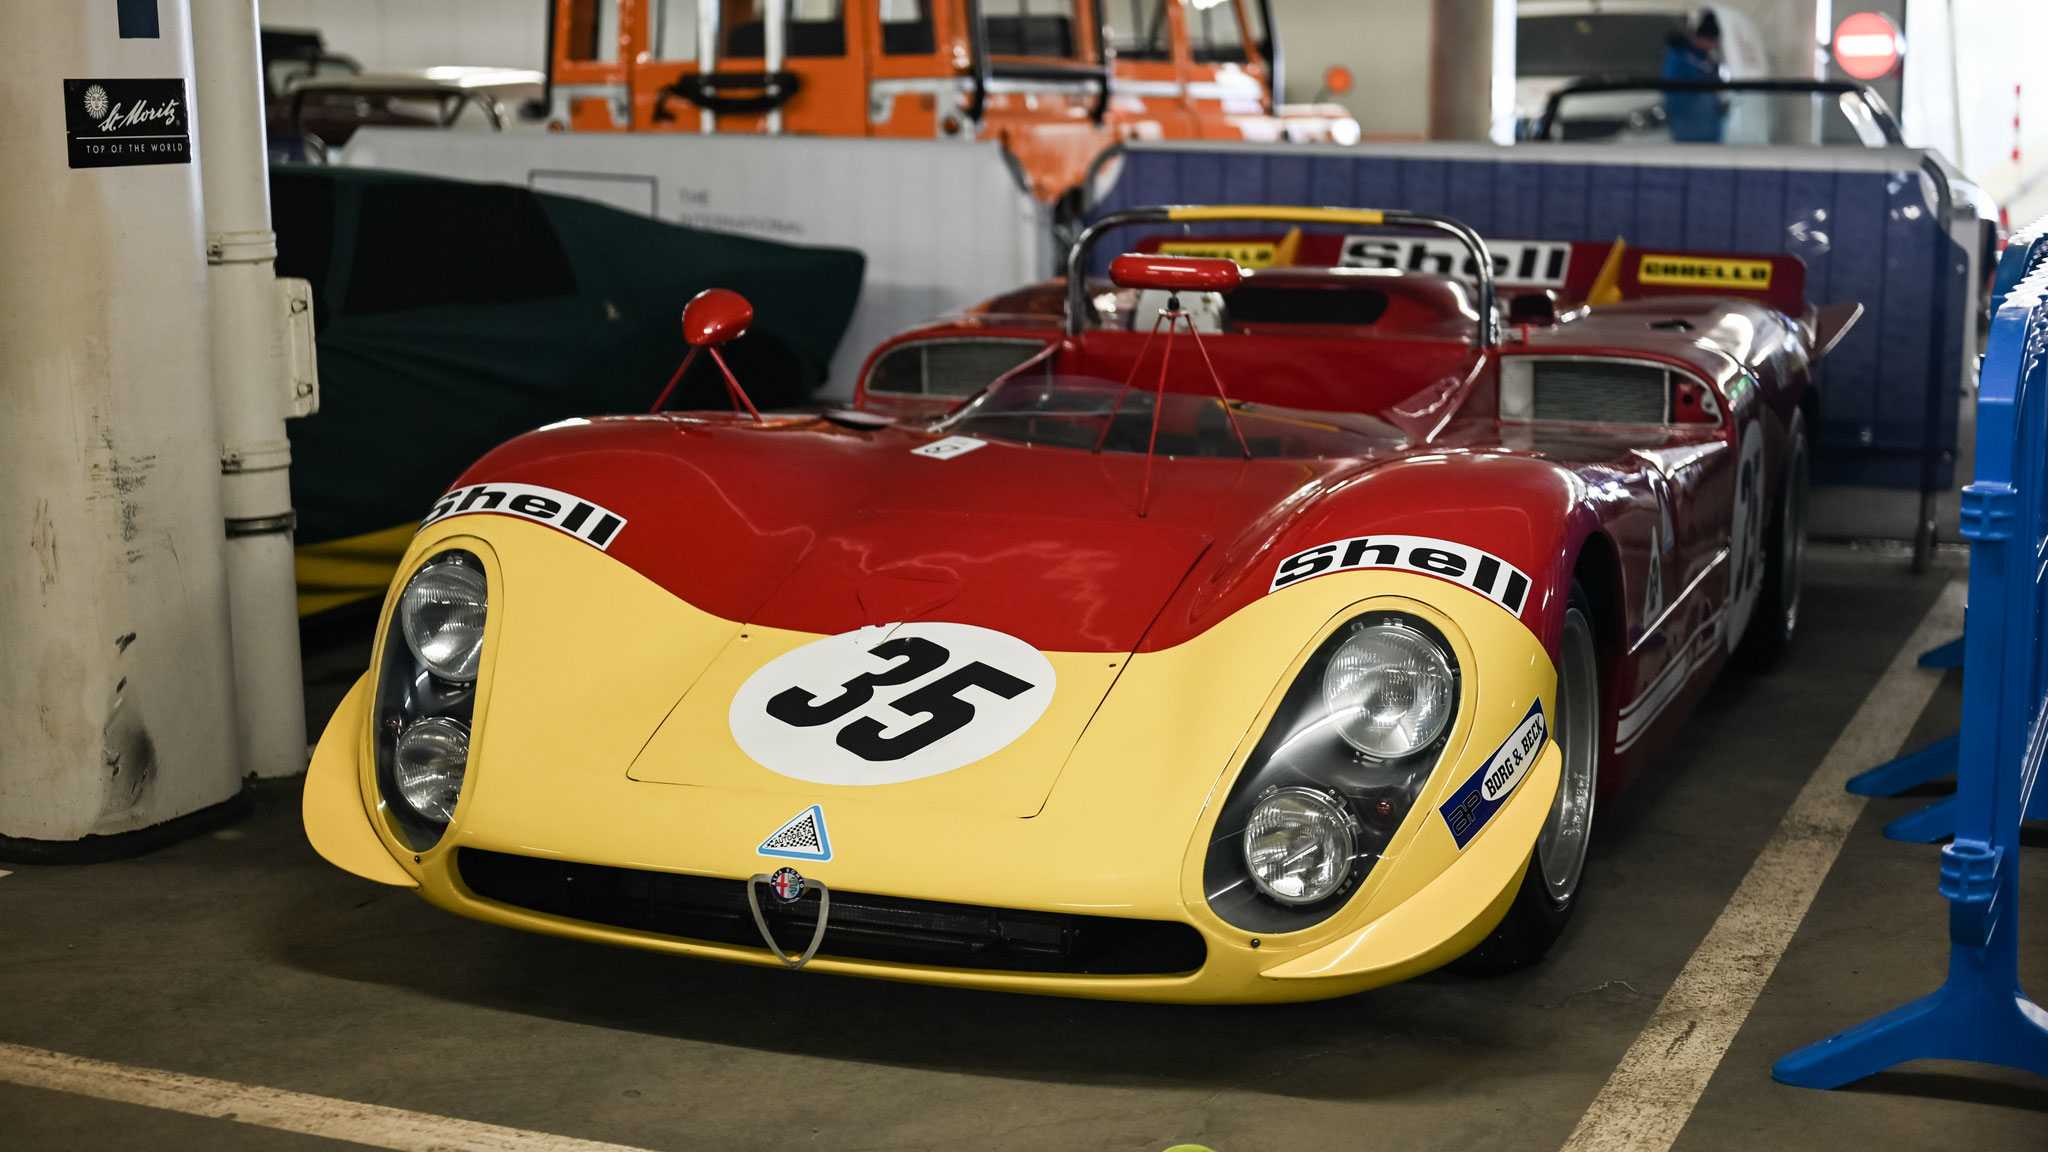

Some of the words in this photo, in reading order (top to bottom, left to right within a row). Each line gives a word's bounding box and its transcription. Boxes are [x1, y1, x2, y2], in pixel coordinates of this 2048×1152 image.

[98, 102, 124, 132] St.
[118, 99, 179, 128] Moritz
[86, 145, 105, 154] TOP
[111, 144, 123, 153] OF
[128, 143, 145, 152] THE
[151, 143, 183, 152] WORLD
[1348, 242, 1565, 280] Shell
[416, 485, 622, 546] Shell
[1275, 538, 1529, 613] Shell
[766, 637, 1035, 762] 35
[1484, 757, 1514, 798] BORG
[1512, 748, 1523, 766] &
[1521, 716, 1543, 756] BECK
[774, 828, 812, 846] AUTODELTA
[771, 870, 783, 886] ALFA
[786, 868, 804, 888] ROMEO
